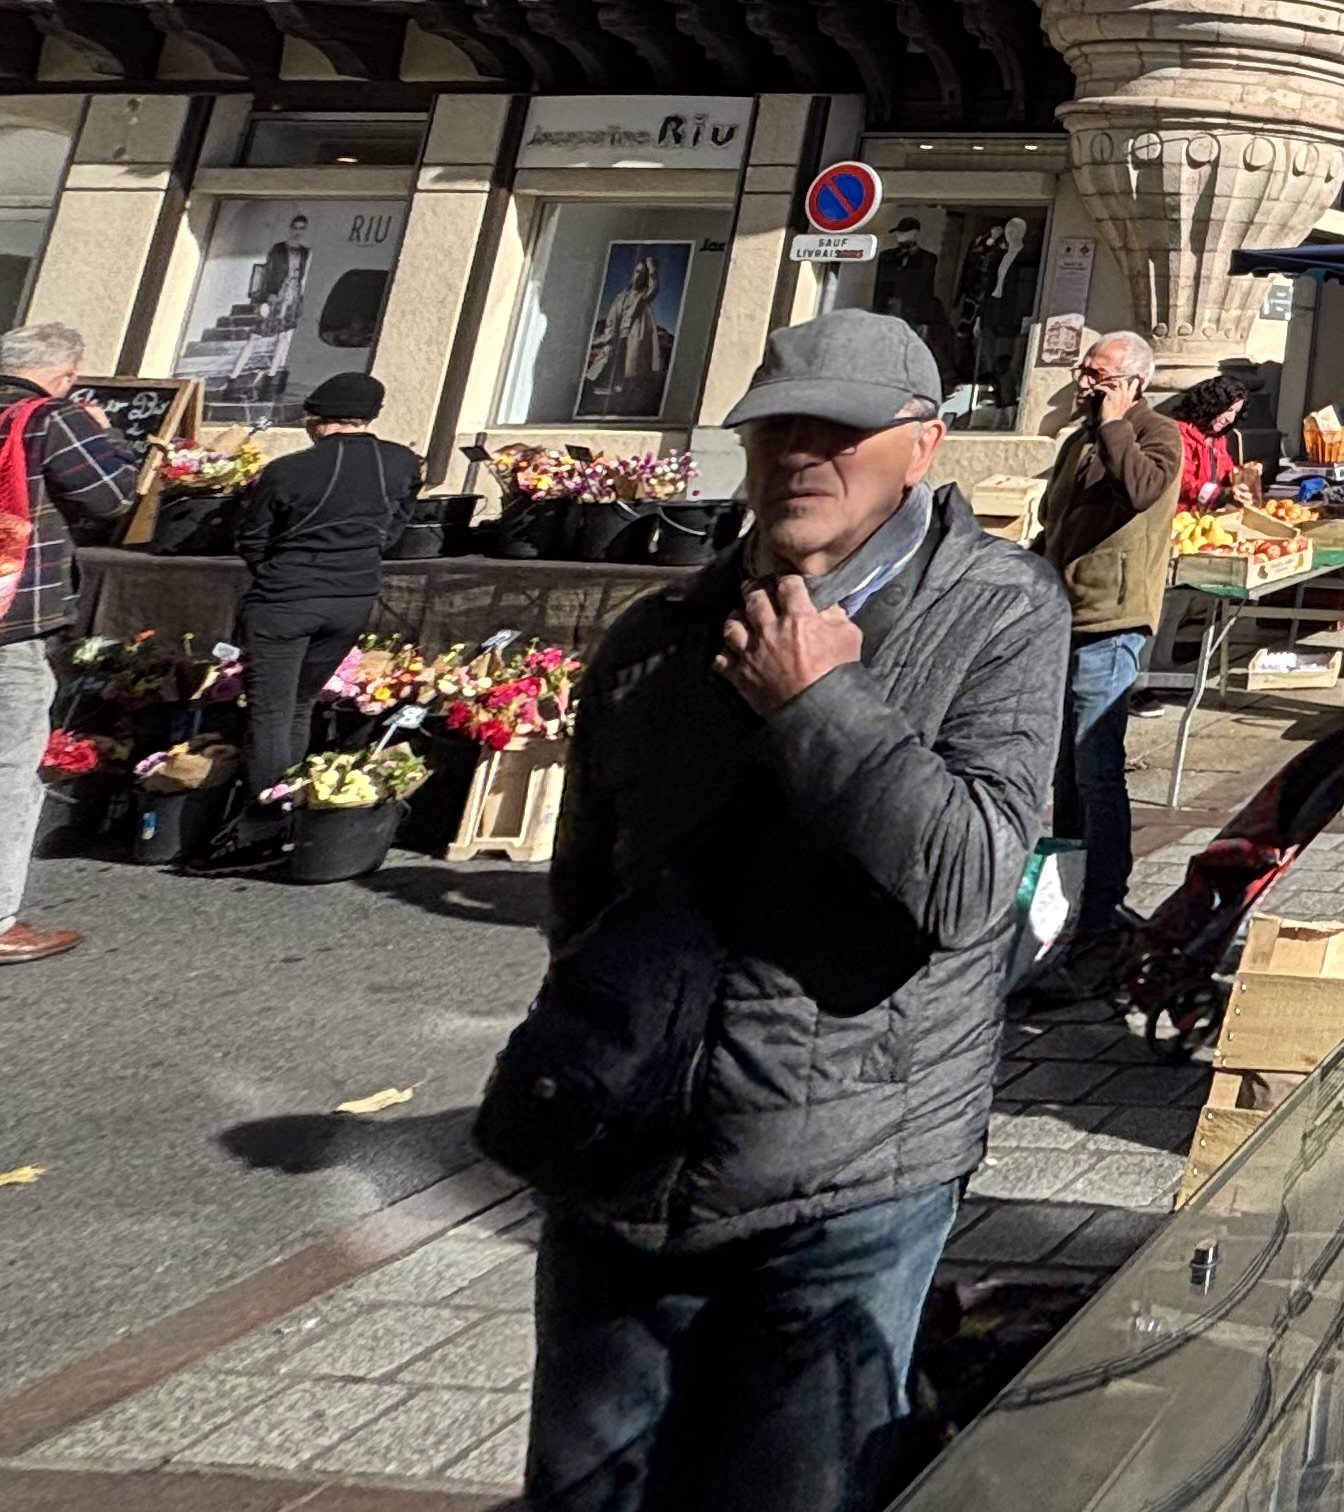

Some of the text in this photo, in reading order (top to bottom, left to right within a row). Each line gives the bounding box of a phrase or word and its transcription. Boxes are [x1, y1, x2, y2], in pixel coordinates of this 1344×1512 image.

[658, 113, 736, 147] Riu
[348, 215, 393, 243] RIU
[818, 238, 849, 248] SAUF
